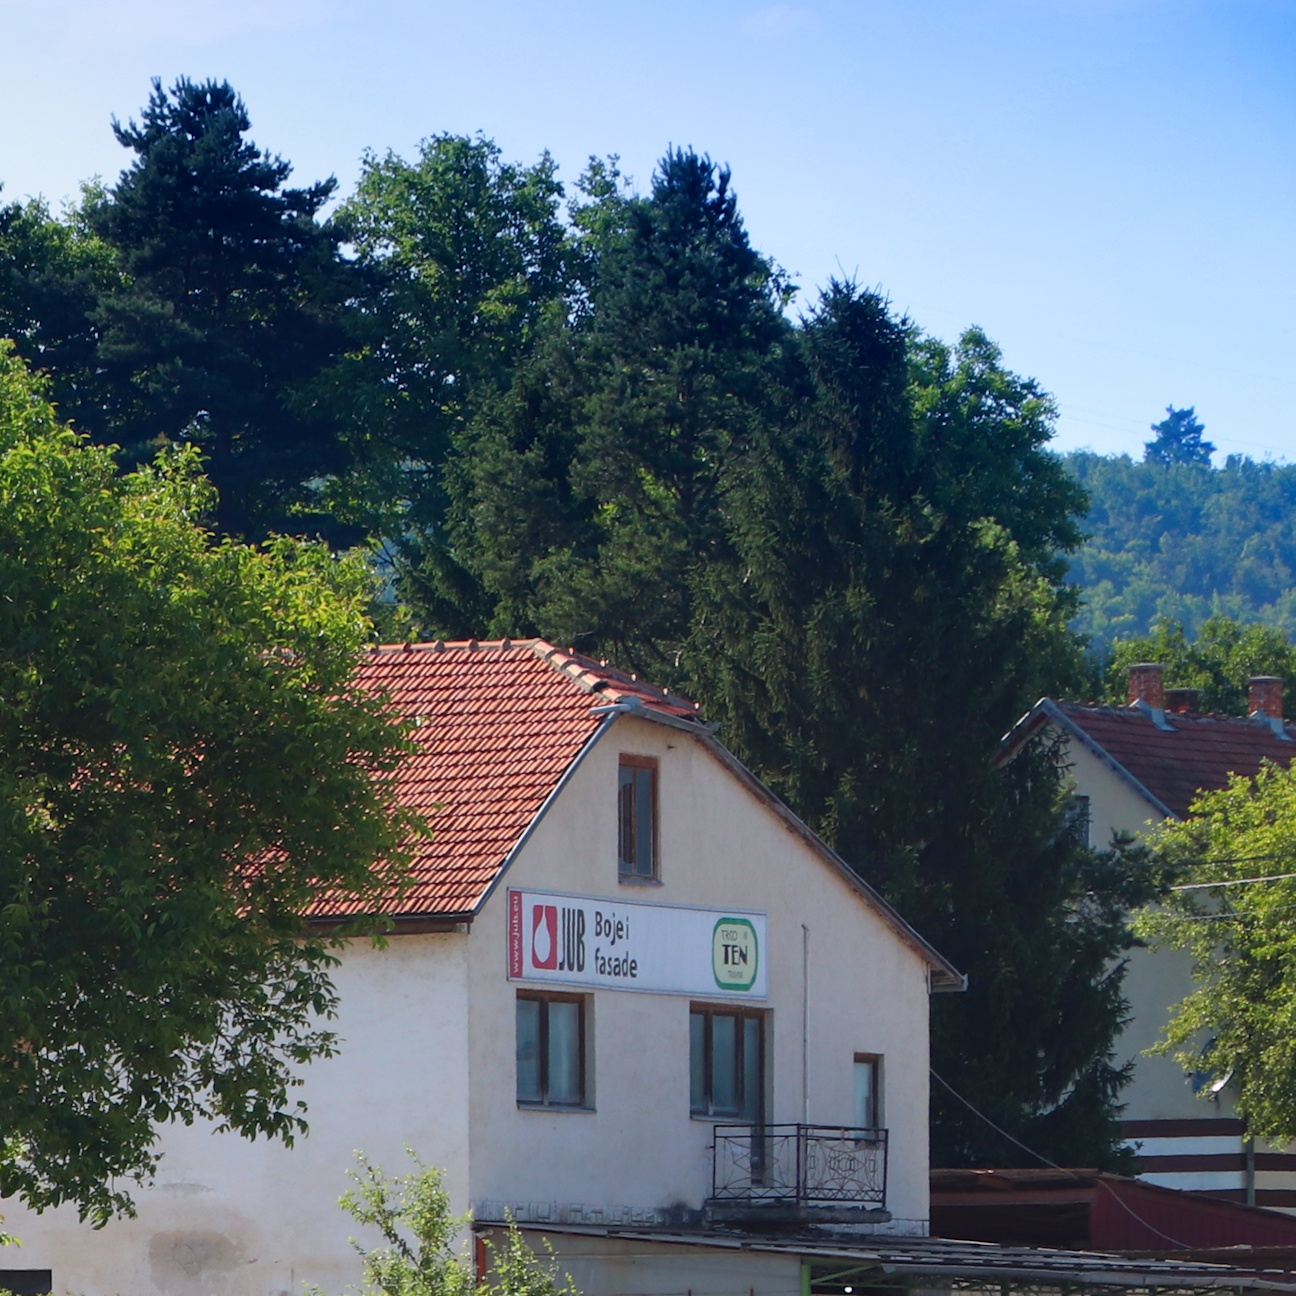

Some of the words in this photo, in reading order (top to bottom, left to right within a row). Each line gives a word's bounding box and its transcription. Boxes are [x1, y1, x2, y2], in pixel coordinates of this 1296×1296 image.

[559, 907, 585, 972] JUB
[595, 911, 624, 946] Boje
[625, 916, 629, 940] i
[594, 947, 638, 978] fasade
[721, 944, 748, 966] TEN
